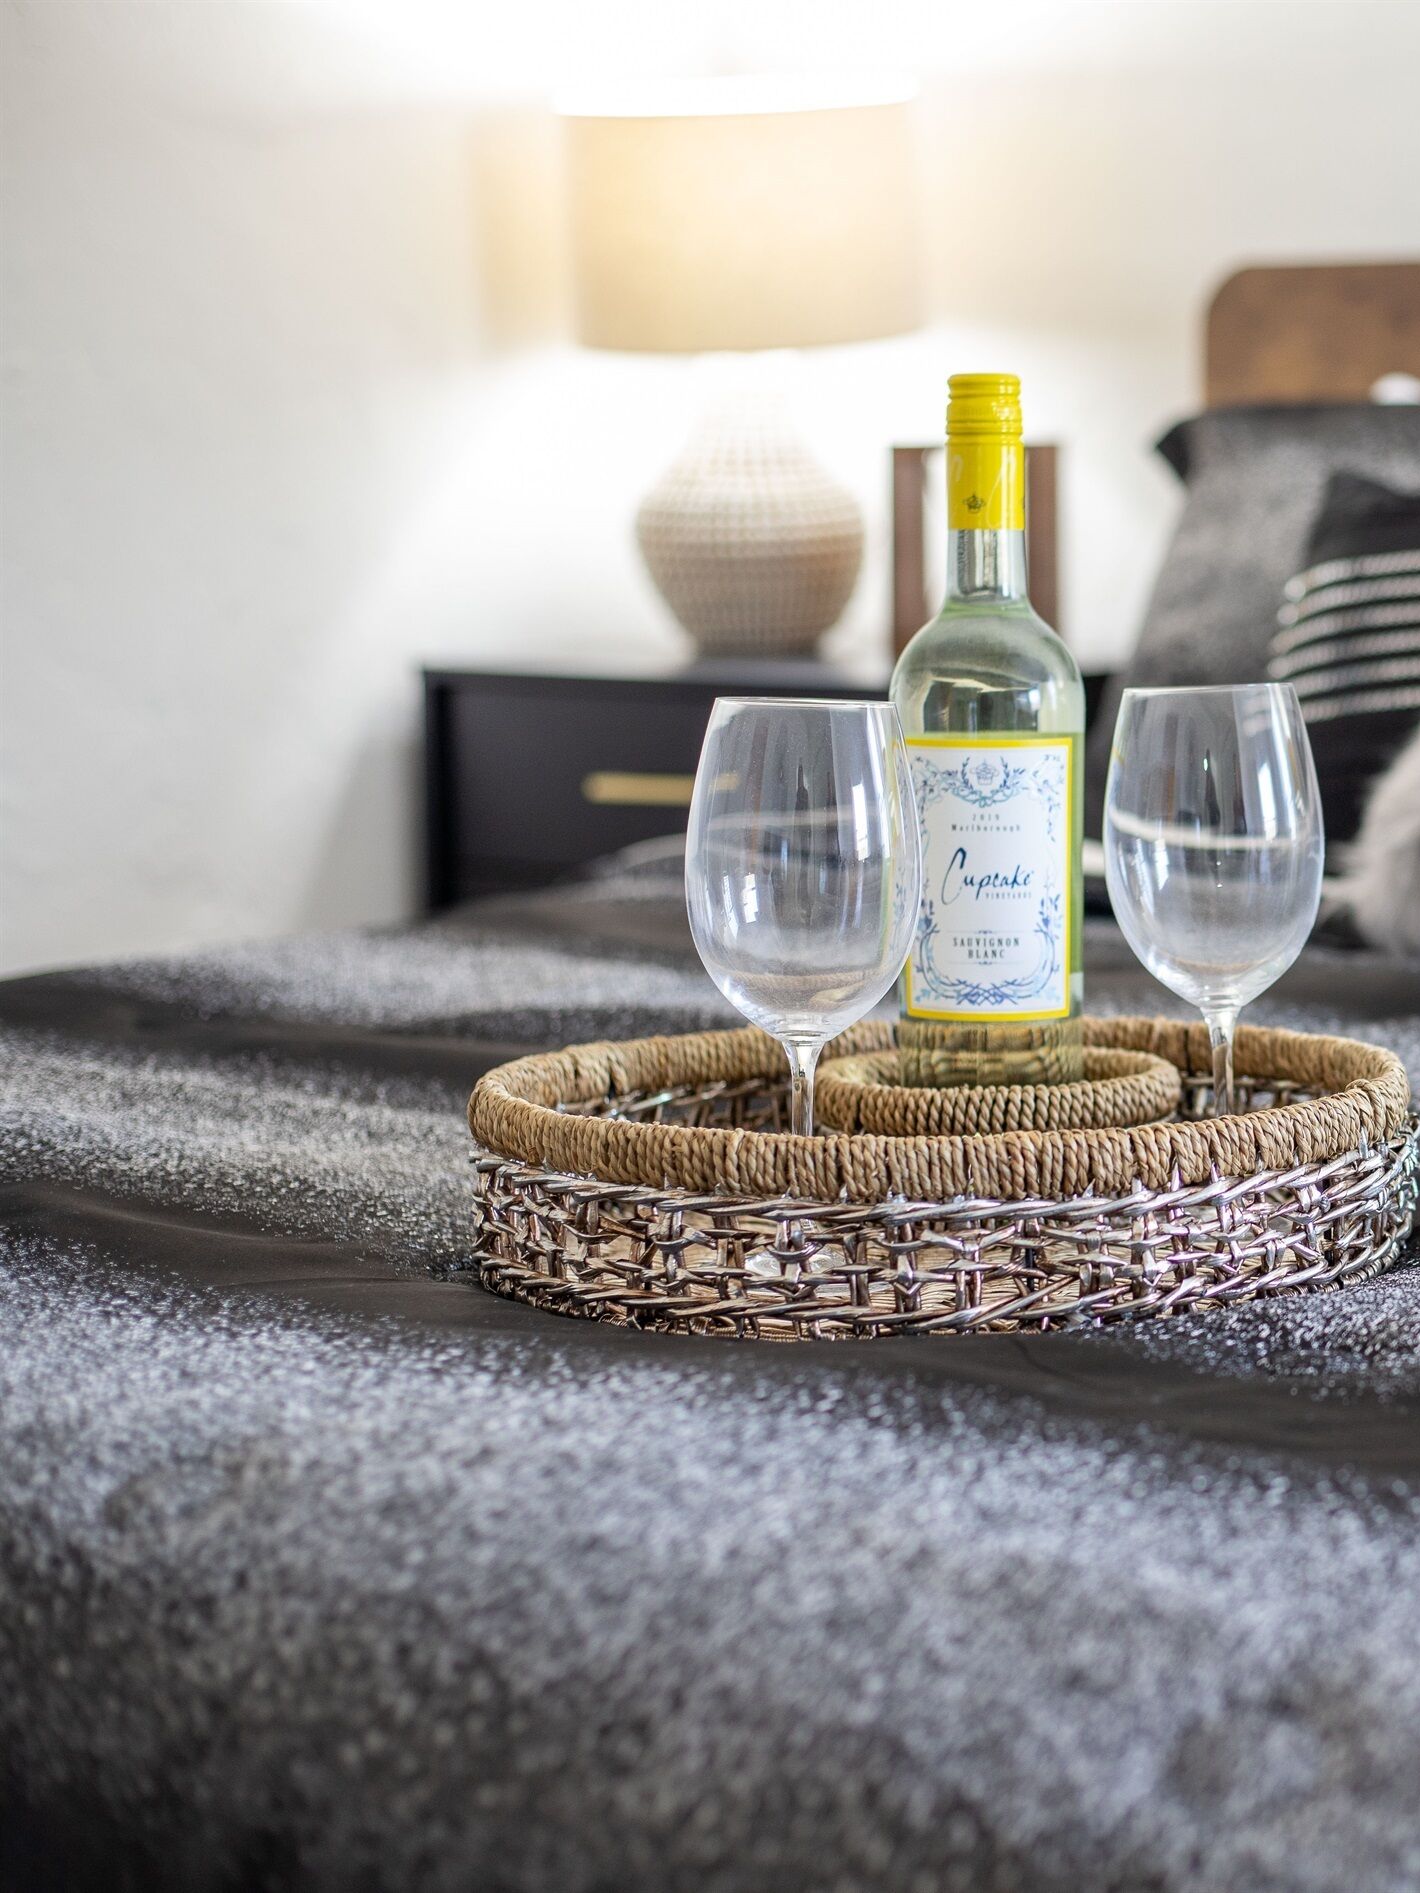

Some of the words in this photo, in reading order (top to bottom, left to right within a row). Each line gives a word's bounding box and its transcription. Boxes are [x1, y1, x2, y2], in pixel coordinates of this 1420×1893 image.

[951, 824, 1021, 833] Marlborough
[941, 847, 1031, 905] Cupcake
[985, 892, 1032, 900] VINEYARDS
[953, 937, 1020, 947] SAUVIGNON
[968, 949, 1005, 959] BLANC
